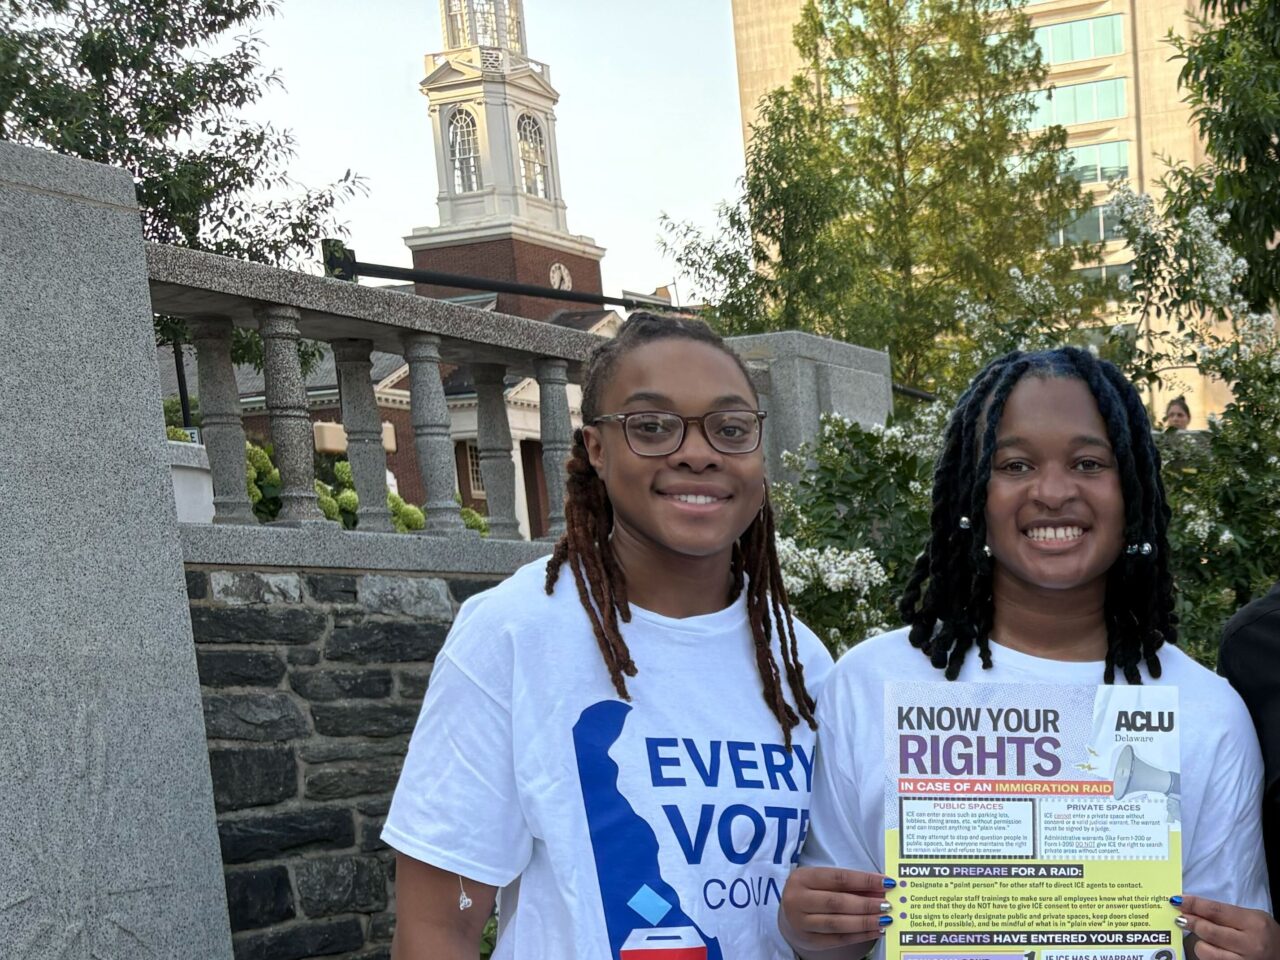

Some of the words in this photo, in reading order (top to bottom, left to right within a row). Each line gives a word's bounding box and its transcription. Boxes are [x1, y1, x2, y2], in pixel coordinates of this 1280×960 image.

[898, 707, 981, 731] KNOW
[987, 708, 1060, 733] YOUR
[1115, 711, 1174, 731] ACLU
[1115, 734, 1153, 743] Delaware
[899, 734, 1062, 777] RIGHTS
[645, 737, 816, 792] EVERY
[901, 782, 913, 791] IN
[917, 782, 950, 791] CASE
[954, 783, 970, 791] OF
[974, 783, 992, 792] AN
[995, 783, 1079, 793] IMMIGRATION
[1082, 784, 1111, 793] RAID
[933, 802, 965, 810] PUBLIC
[901, 866, 930, 876] HOW
[933, 867, 950, 876] TO
[953, 867, 1008, 876] PREPARE
[1011, 867, 1034, 876] FOR
[1038, 867, 1047, 876] A
[1050, 867, 1082, 876] RAID:
[902, 933, 913, 943] IF
[916, 933, 936, 943] ICE
[940, 933, 990, 943] AGENTS
[993, 933, 1028, 943] HAVE
[1031, 933, 1086, 943] ENTERED
[1090, 933, 1123, 943] YOUR
[1127, 933, 1169, 943] SPACE:
